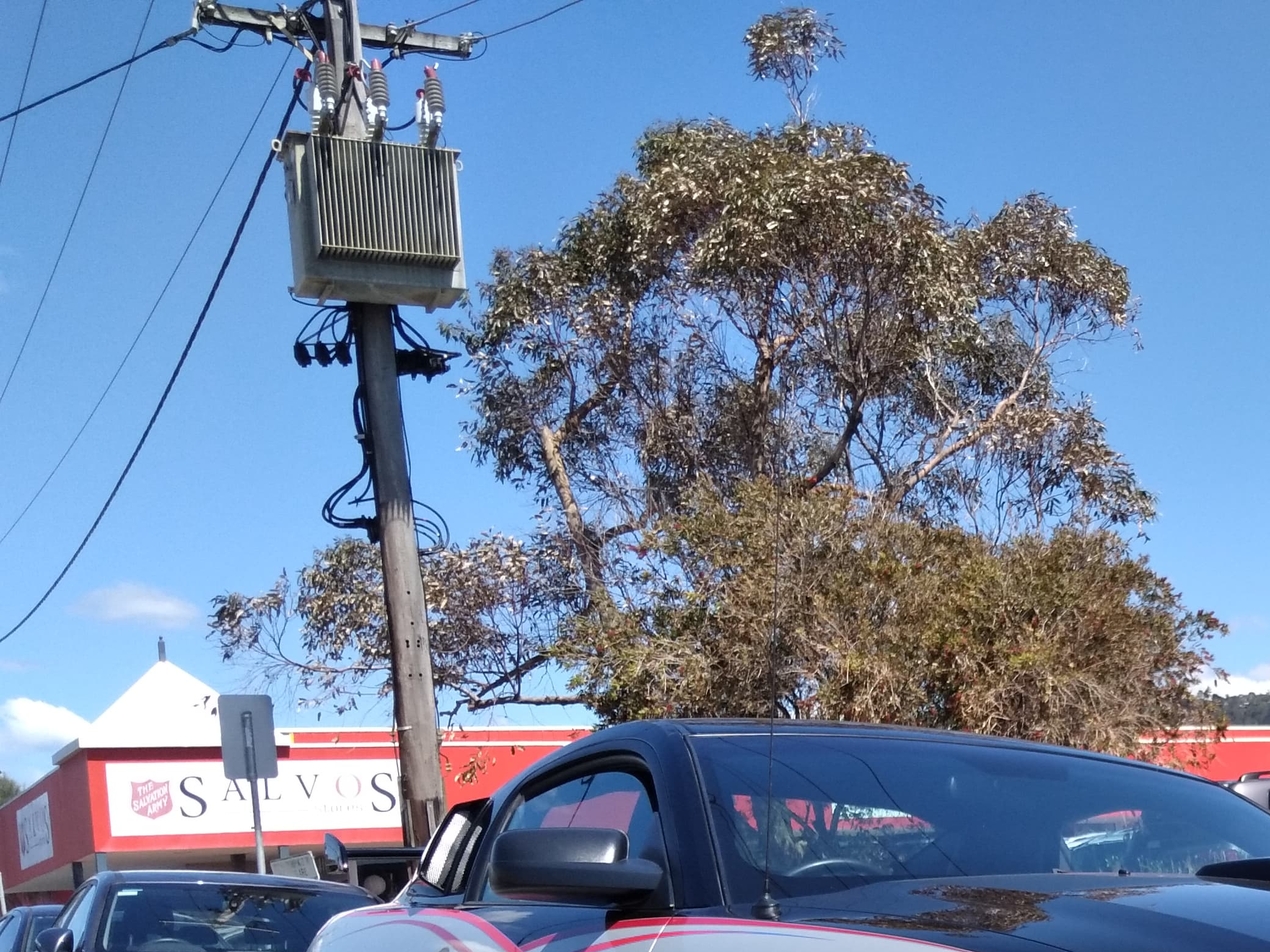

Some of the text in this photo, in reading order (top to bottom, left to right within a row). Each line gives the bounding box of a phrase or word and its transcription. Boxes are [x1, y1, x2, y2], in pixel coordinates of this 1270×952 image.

[133, 783, 169, 812] SALVATION
[137, 781, 154, 797] THE
[179, 772, 397, 819] SALVOS
[147, 795, 169, 817] ARMY
